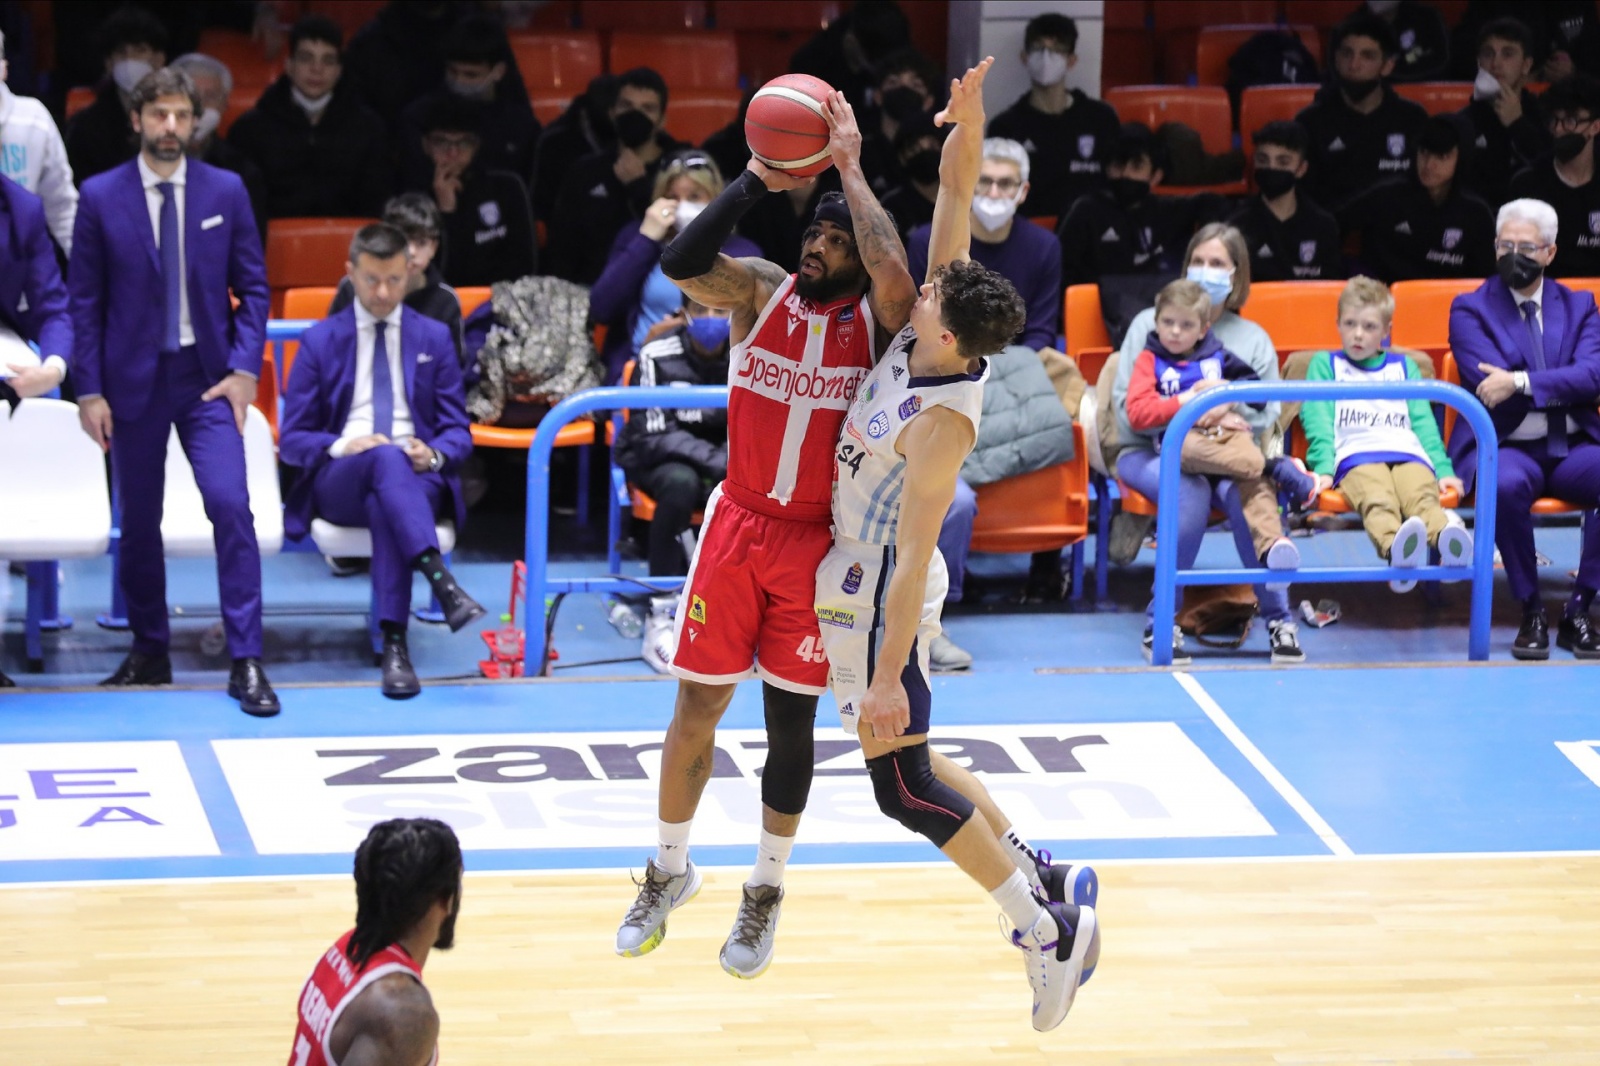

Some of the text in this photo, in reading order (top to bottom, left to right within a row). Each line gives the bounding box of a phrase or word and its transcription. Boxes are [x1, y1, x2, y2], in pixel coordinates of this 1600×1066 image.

[0, 143, 27, 173] ISI
[1338, 407, 1406, 430] HAPPY ASA
[796, 635, 828, 663] 45
